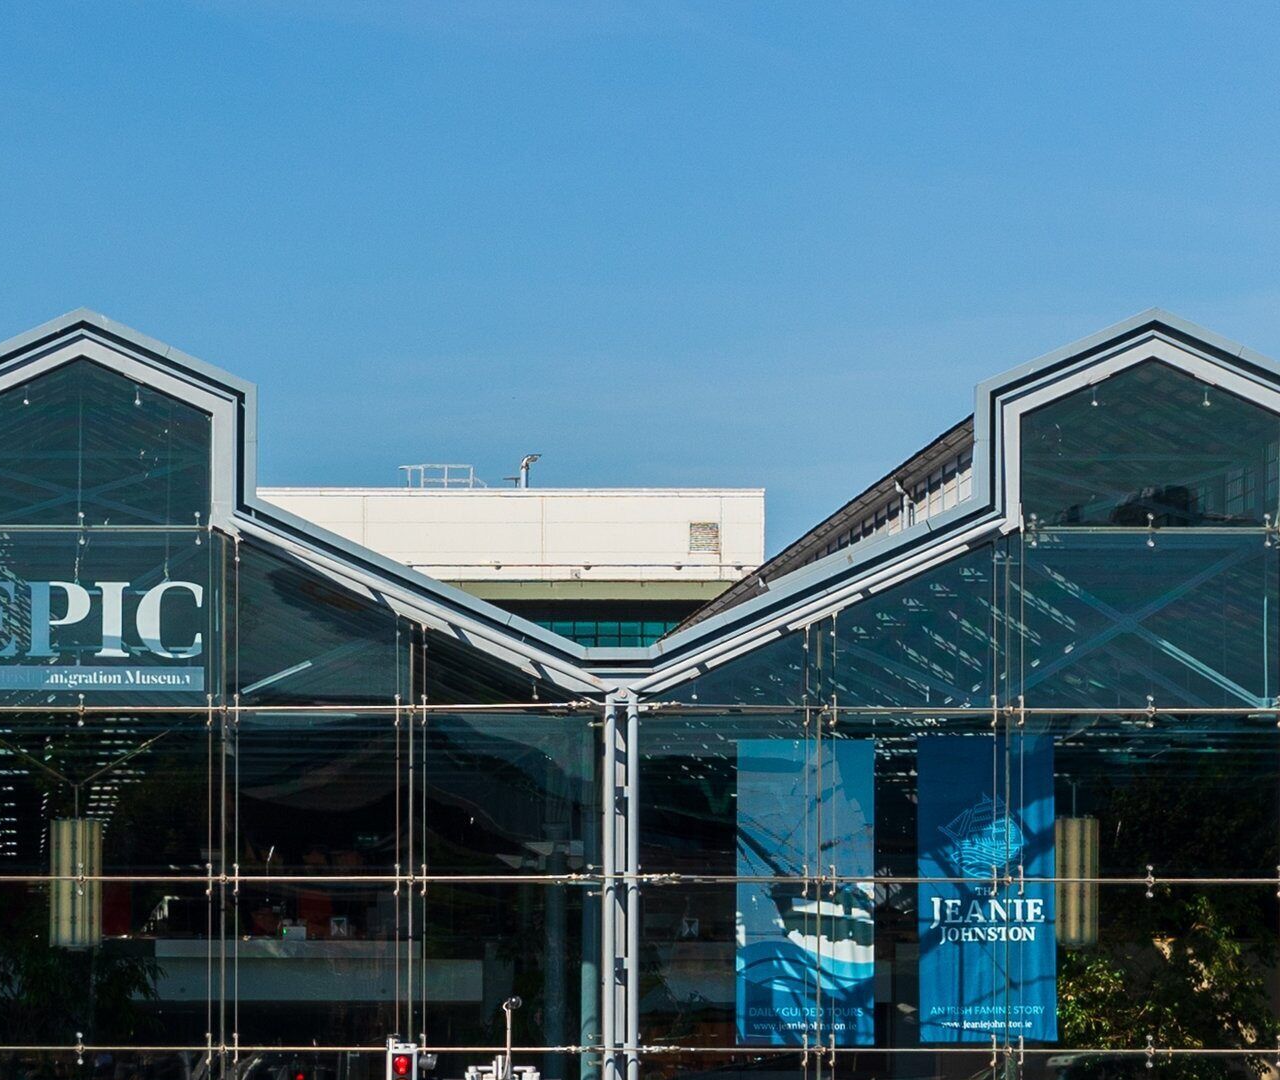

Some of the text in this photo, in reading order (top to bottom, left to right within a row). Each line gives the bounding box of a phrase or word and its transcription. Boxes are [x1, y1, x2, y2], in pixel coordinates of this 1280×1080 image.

[125, 669, 191, 685] Museum
[974, 886, 999, 896] TH
[930, 896, 1045, 929] JEANIE
[940, 926, 1036, 945] JOHNSTON
[748, 1007, 864, 1017] DAILY GUIDED TOURS
[930, 1006, 945, 1015] AN
[947, 1006, 973, 1015] IRISH
[1013, 1006, 1045, 1015] STORY
[941, 1020, 1033, 1030] www.jeaniejohnton.ie
